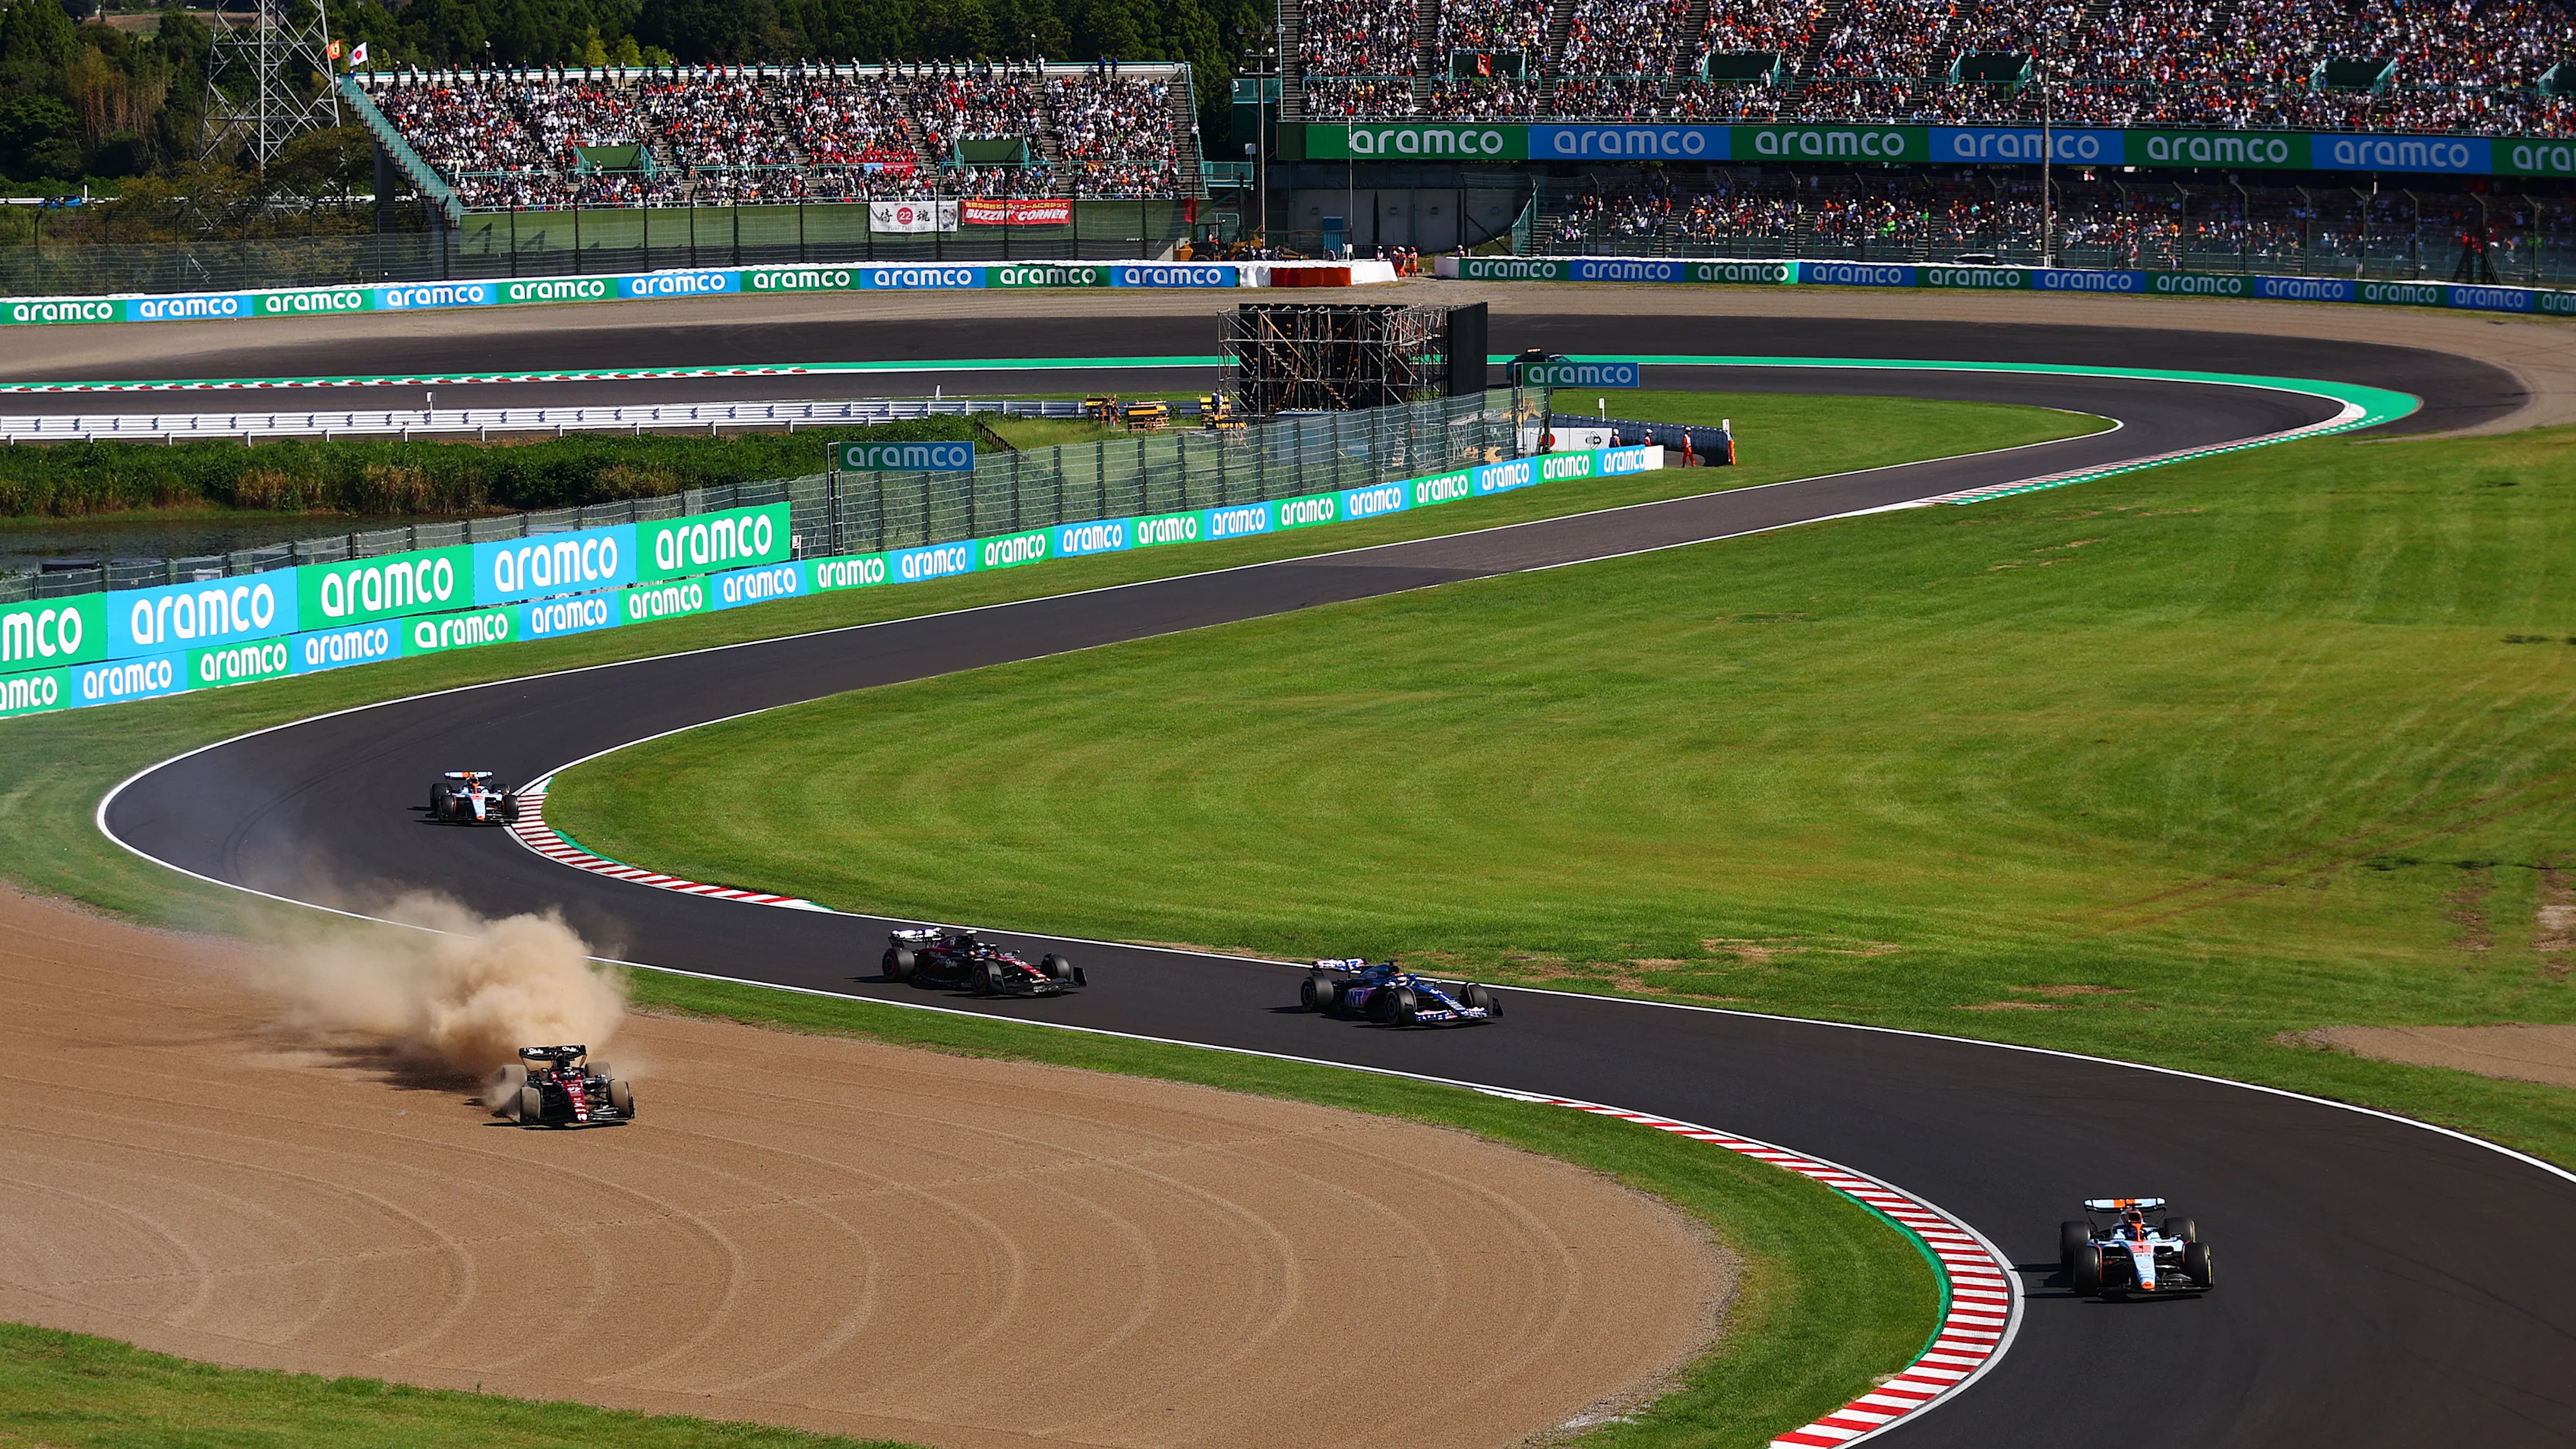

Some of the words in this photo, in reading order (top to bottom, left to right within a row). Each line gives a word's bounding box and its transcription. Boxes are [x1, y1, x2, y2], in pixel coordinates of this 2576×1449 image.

[1351, 130, 1503, 153] aramco
[1555, 131, 1705, 154] aramco
[1756, 131, 1904, 156] aramco
[1954, 134, 2099, 159] aramco
[2148, 137, 2287, 163] aramco
[2334, 140, 2468, 167] aramco
[2513, 146, 2576, 171] ara
[879, 207, 893, 223] 侍
[899, 211, 912, 221] 22
[916, 210, 930, 222] 魂
[1018, 209, 1069, 221] CORNER
[754, 271, 850, 288] aramco
[875, 270, 971, 286] aramco
[1000, 269, 1095, 284] aramco
[1125, 269, 1221, 284] aramco
[1470, 261, 1556, 277] aramco
[1583, 264, 1671, 279] aramco
[1698, 265, 1788, 282] aramco
[1814, 266, 1901, 283] aramco
[1929, 269, 2020, 286] aramco
[2045, 273, 2132, 289] aramco
[387, 286, 484, 306] aramco
[510, 281, 605, 299] aramco
[632, 275, 725, 294] aramco
[2157, 276, 2241, 293] aramco
[2265, 279, 2344, 298] aramco
[2365, 283, 2438, 303] aramco
[140, 298, 237, 317] aramco
[266, 292, 361, 311] aramco
[2454, 288, 2524, 308] aramco
[14, 303, 112, 320] aramco
[1530, 366, 1631, 383] aramco
[847, 447, 967, 466] aramco
[1543, 454, 1590, 480] aramco
[1604, 449, 1645, 473] aramco
[1482, 462, 1530, 491] aramco
[1350, 486, 1401, 516] aramco
[1416, 474, 1469, 504] aramco
[1212, 507, 1265, 535] aramco
[1281, 497, 1334, 526] aramco
[656, 515, 772, 570] aramco
[1063, 524, 1122, 553] aramco
[1138, 516, 1197, 545] aramco
[984, 533, 1046, 566] aramco
[495, 537, 617, 592] aramco
[818, 558, 885, 588] aramco
[902, 547, 965, 578] aramco
[321, 557, 453, 617] aramco
[724, 568, 796, 602] aramco
[131, 583, 274, 644] aramco
[630, 584, 702, 619] aramco
[532, 598, 607, 633] aramco
[415, 614, 508, 648] aramco
[306, 628, 388, 665] aramco
[200, 643, 287, 680] aramco
[83, 659, 172, 699] aramco
